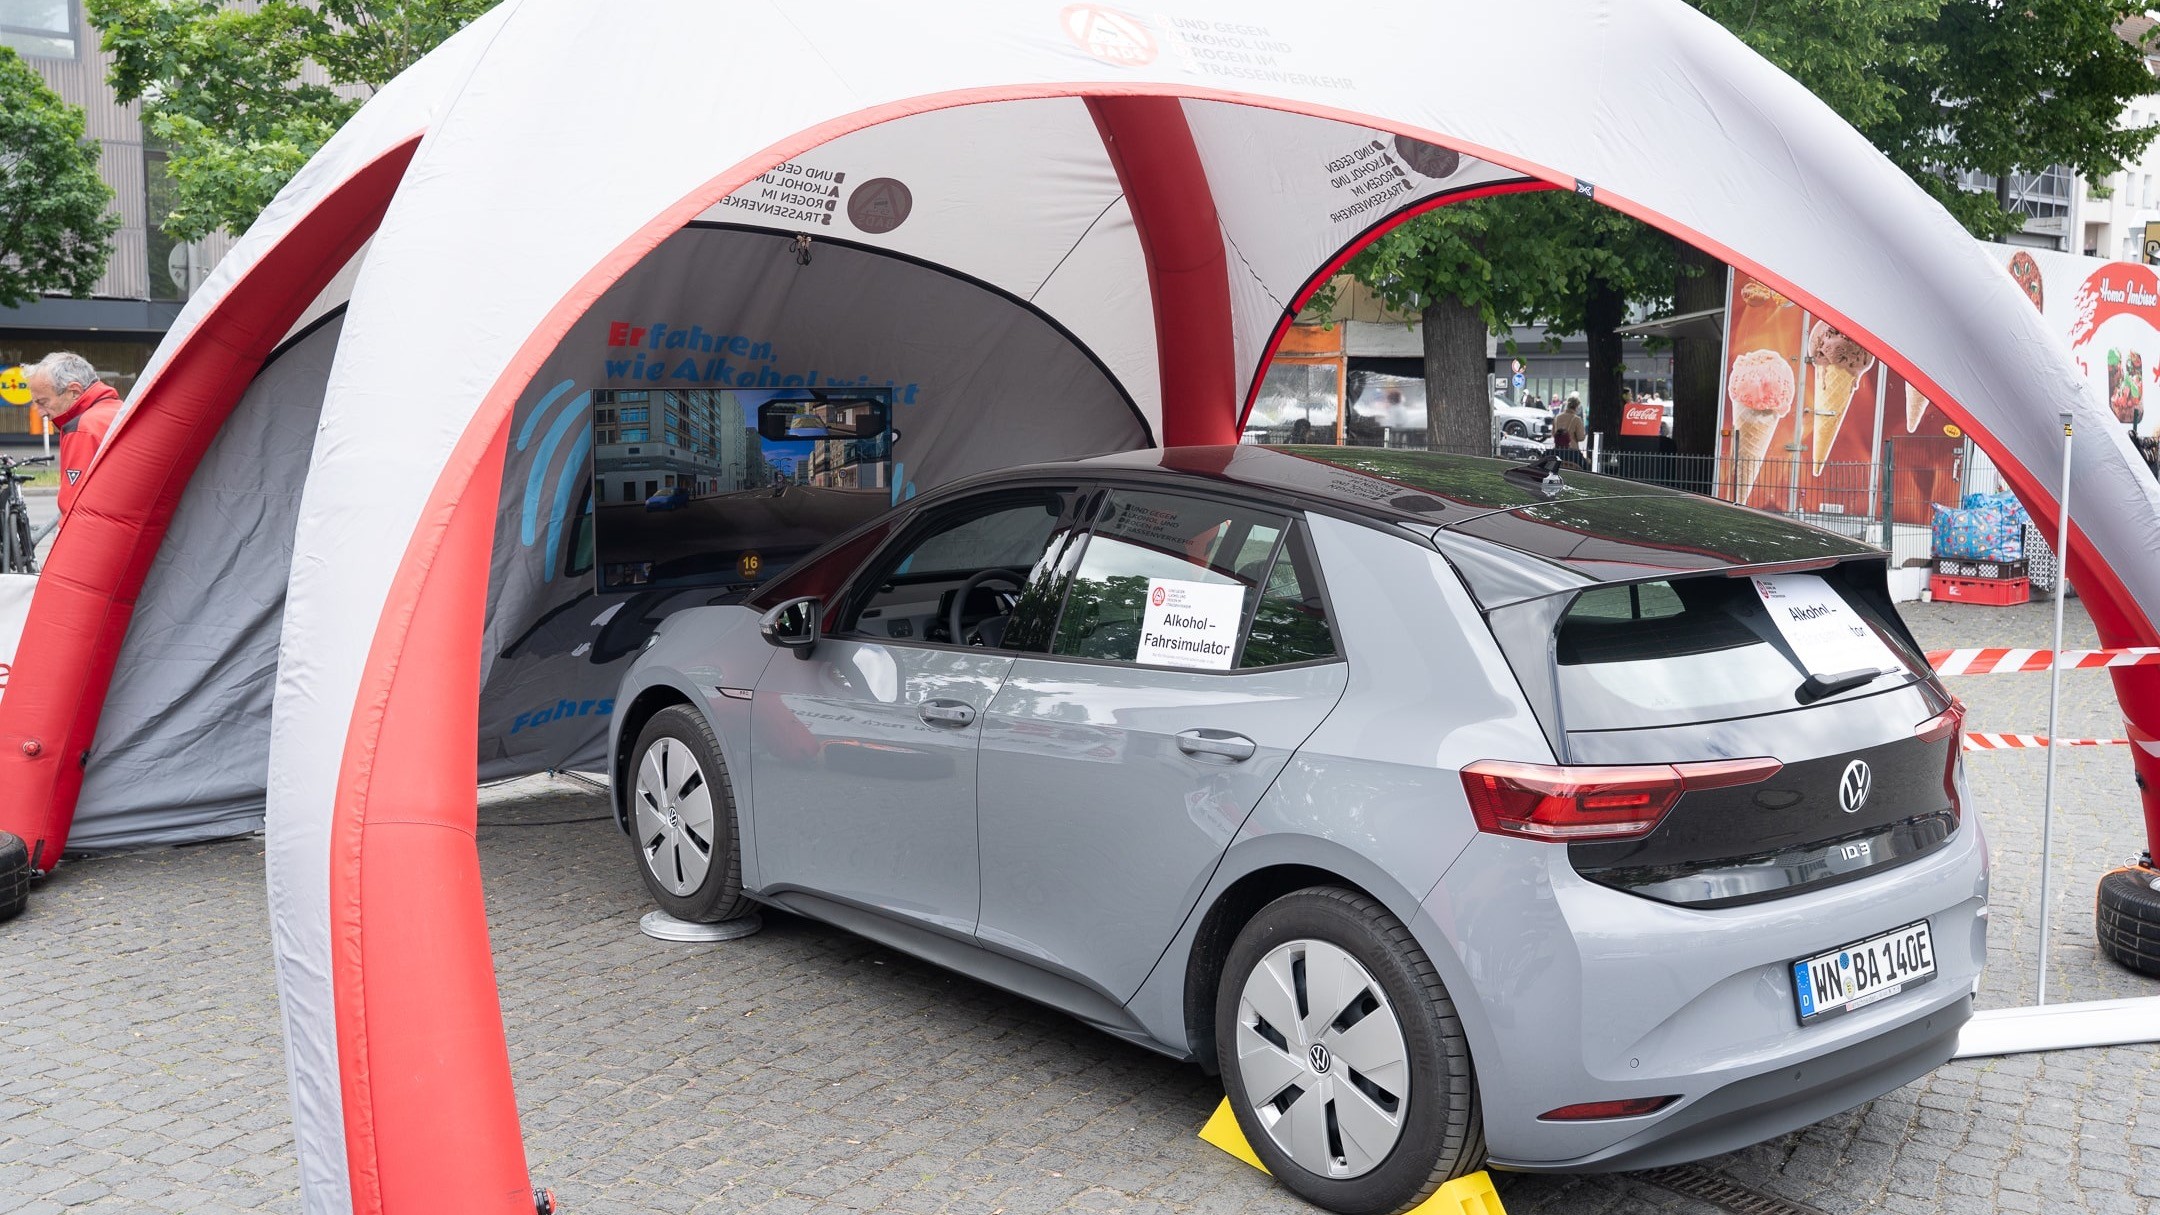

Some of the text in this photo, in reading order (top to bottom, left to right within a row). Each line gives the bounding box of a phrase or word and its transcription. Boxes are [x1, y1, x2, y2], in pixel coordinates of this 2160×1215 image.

[1214, 21, 1270, 37] GEGEN
[1255, 40, 1292, 54] UND
[1256, 55, 1279, 67] IM
[608, 320, 777, 363] Erfahren,
[605, 353, 665, 381] wie
[671, 357, 818, 388] Alkohol
[743, 556, 758, 570] 16
[1164, 613, 1208, 630] Alkohol
[1144, 633, 1231, 656] Fahrsimulator
[1812, 958, 1843, 1003] WN
[1853, 947, 1882, 991] BA
[1883, 930, 1931, 981] 140E
[1803, 994, 1810, 1007] D
